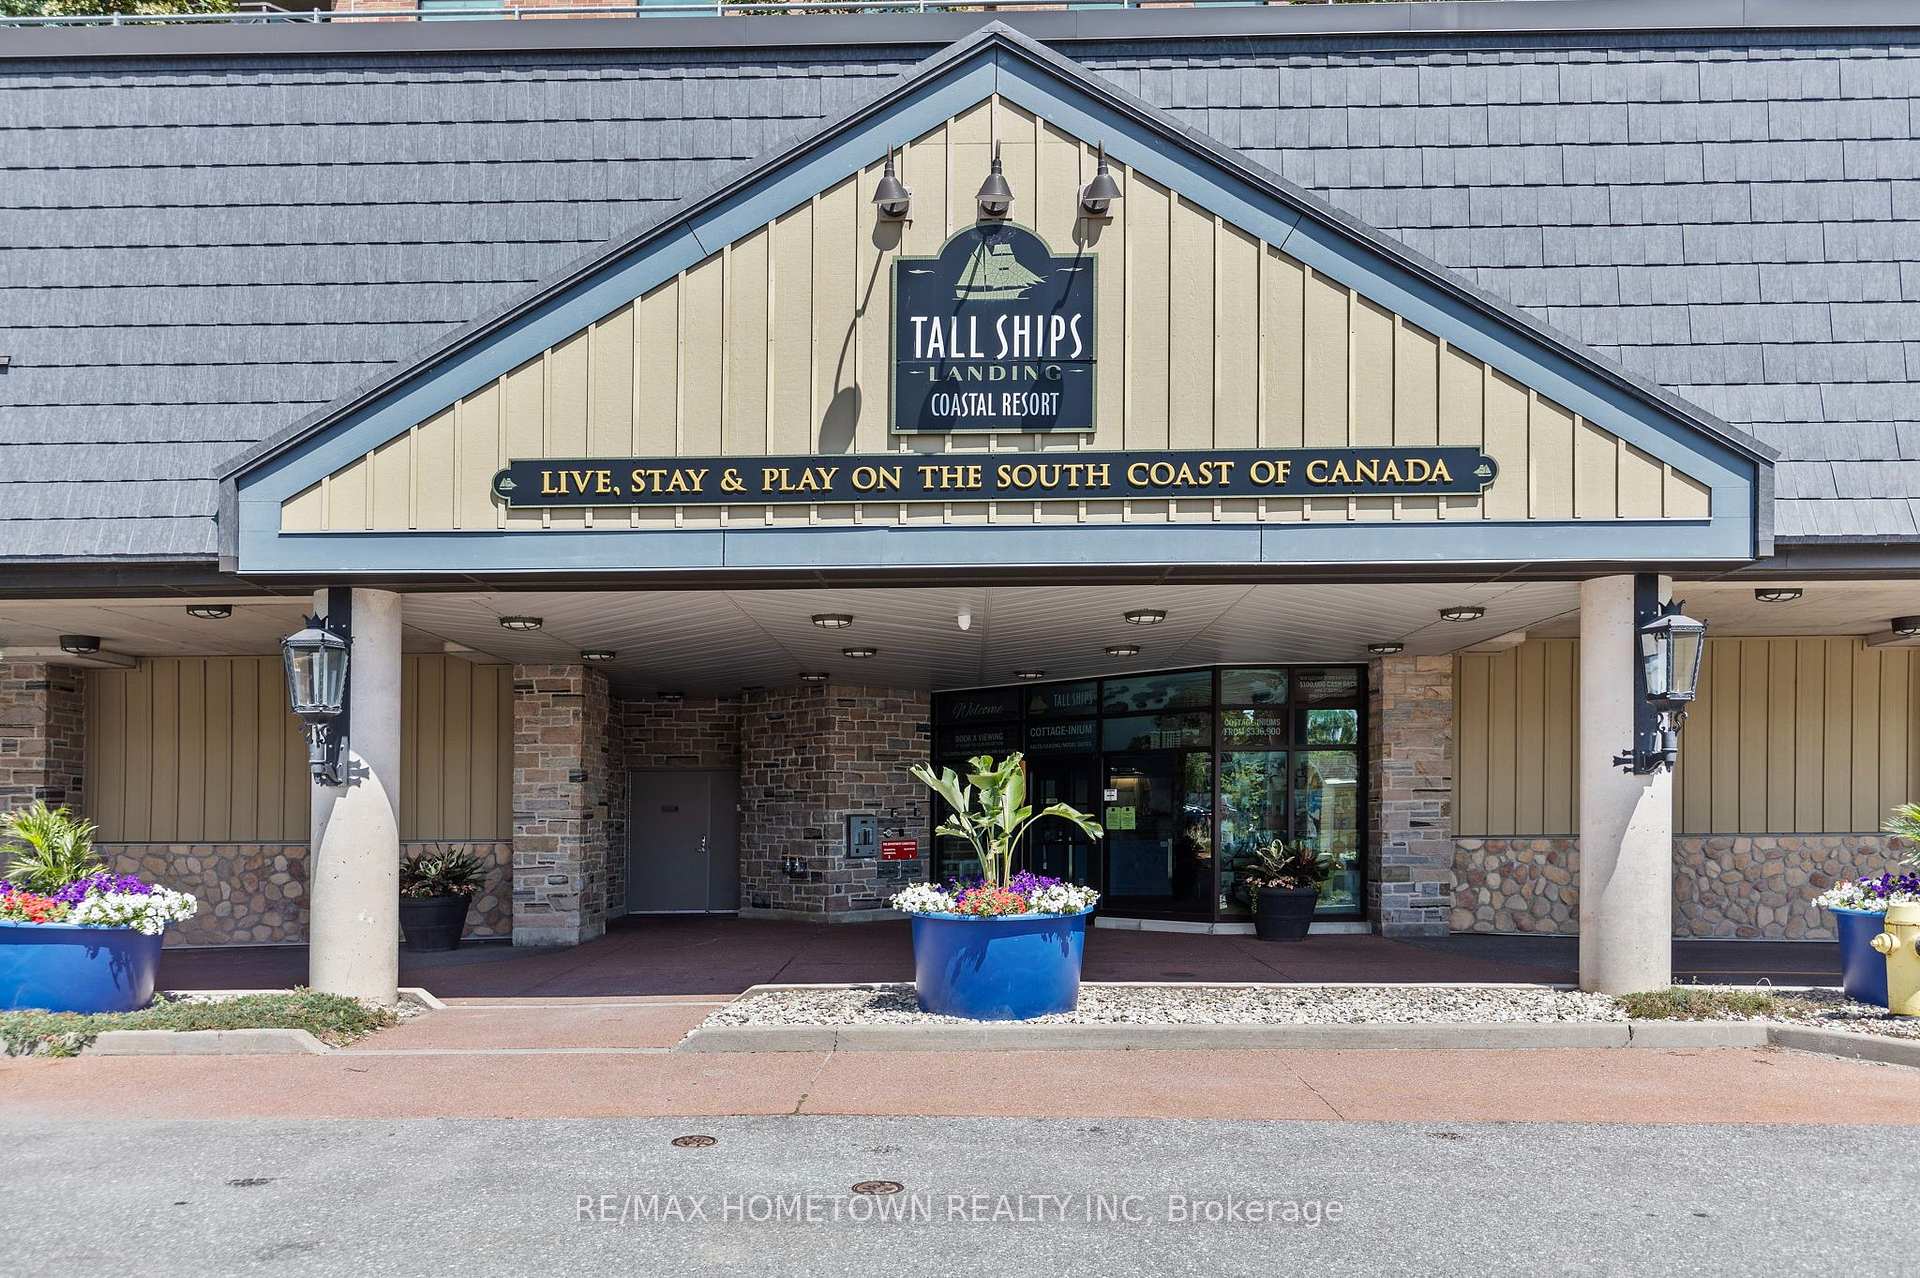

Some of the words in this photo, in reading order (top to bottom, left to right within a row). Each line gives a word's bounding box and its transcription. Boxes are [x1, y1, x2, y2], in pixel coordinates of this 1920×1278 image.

[911, 316, 984, 359] TALL
[995, 313, 1083, 359] SHIPS
[929, 365, 1062, 382] LANDING
[931, 392, 996, 417] COASTAL
[1002, 392, 1060, 417] RESORT
[541, 470, 620, 496] LIVE,
[631, 469, 709, 493] STAY
[720, 468, 747, 492] &
[762, 467, 839, 491] PLAY
[852, 466, 903, 490] ON
[919, 465, 982, 489] THE
[997, 463, 1111, 488] SOUTH
[1127, 462, 1234, 486] COAST
[1250, 460, 1291, 484] OF
[1306, 458, 1453, 483] CANADA
[1053, 694, 1071, 707] TALL
[1030, 724, 1092, 738] COTTAGE-INIUM
[1224, 727, 1245, 737] FROM
